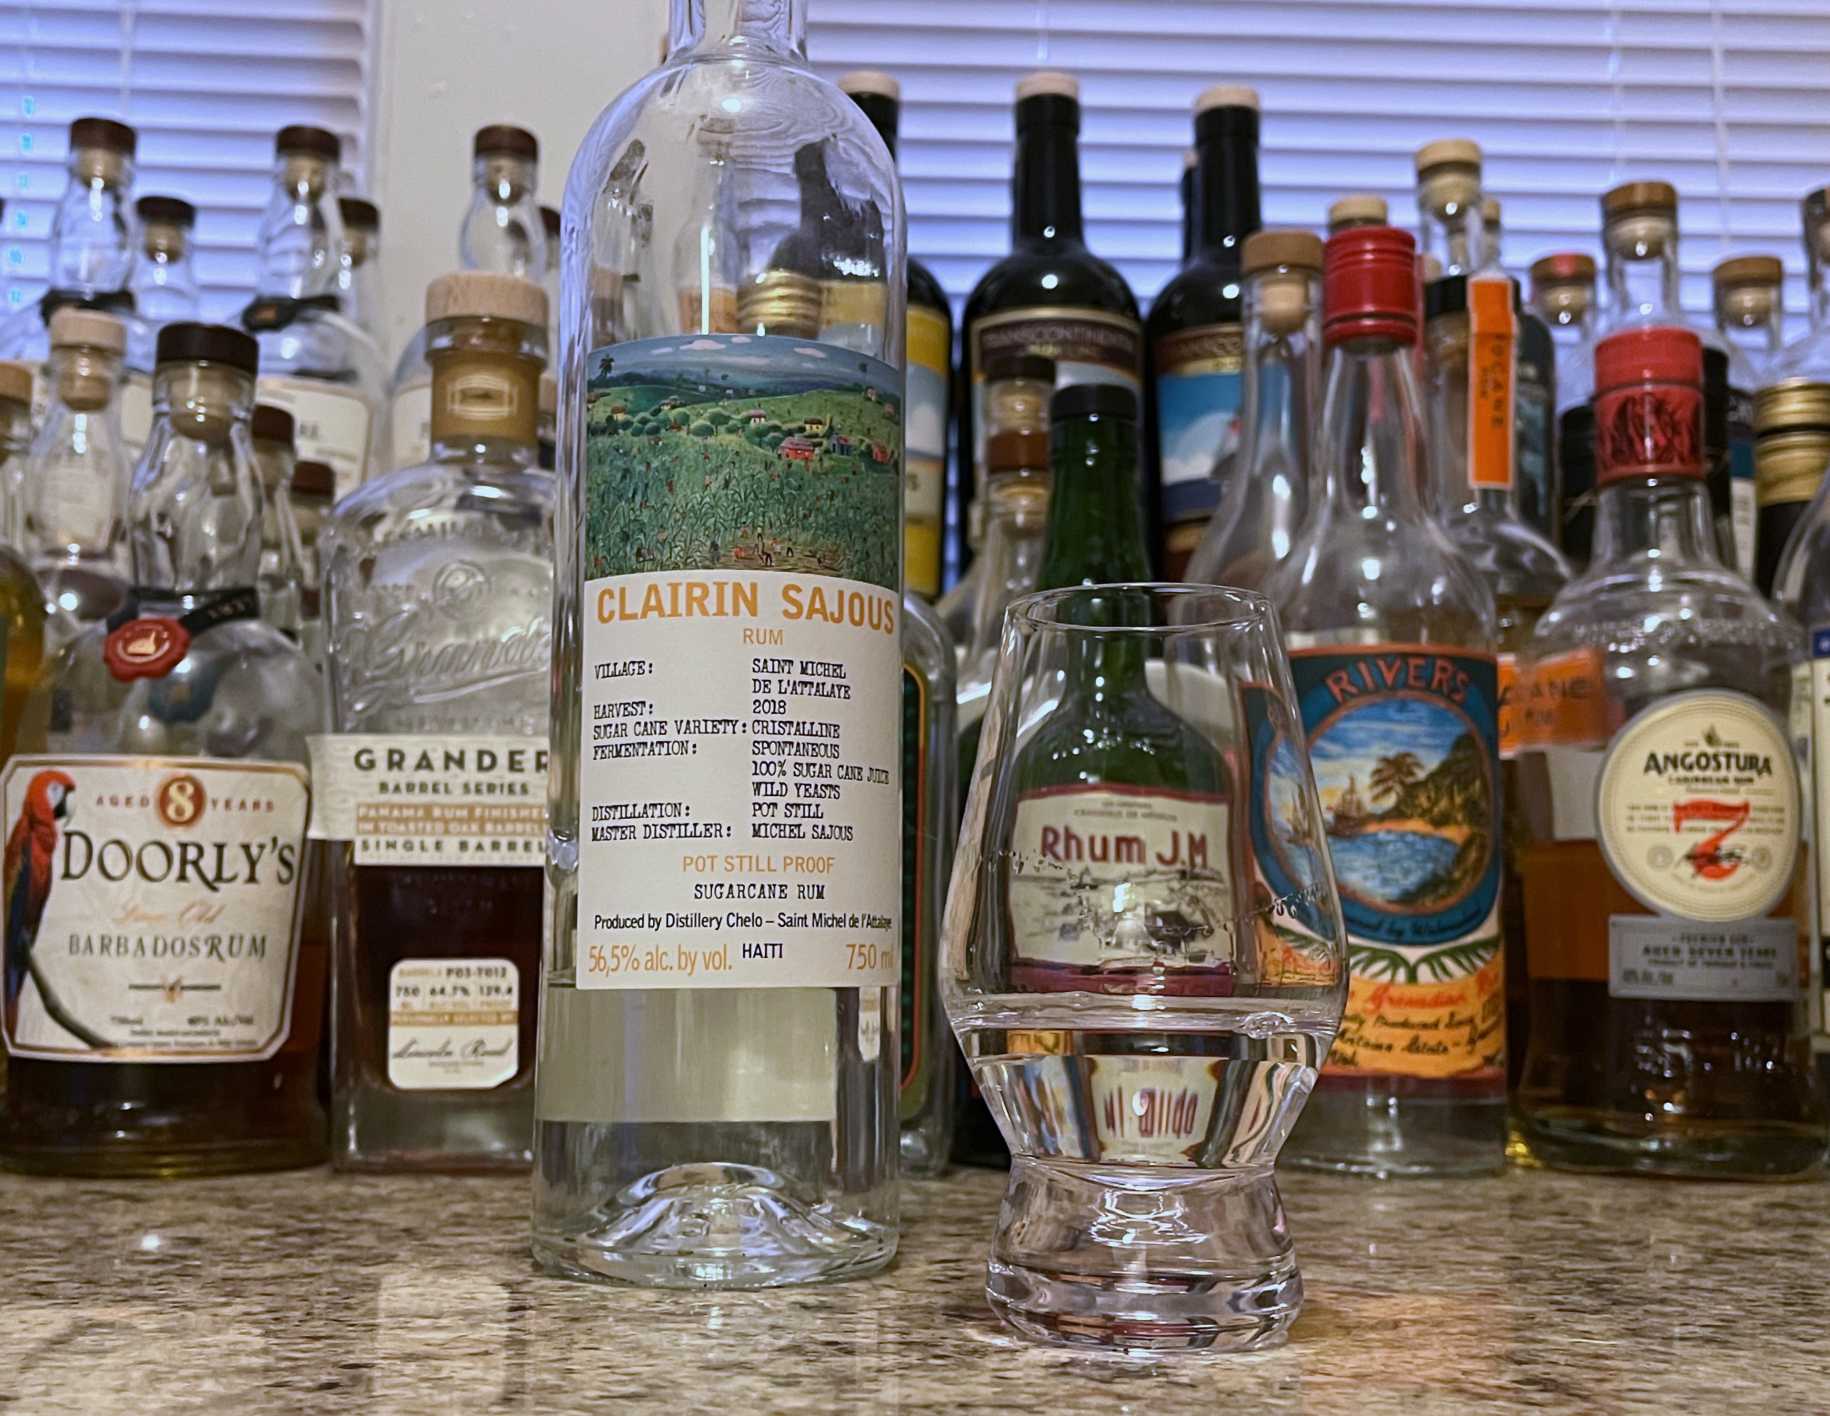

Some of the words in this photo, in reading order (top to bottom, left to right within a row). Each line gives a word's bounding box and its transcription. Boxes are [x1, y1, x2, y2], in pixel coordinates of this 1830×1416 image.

[598, 581, 758, 624] CLAIRIN
[781, 583, 895, 635] SAJOUS
[743, 628, 784, 645] RUM
[594, 661, 653, 679] VILLAGE:
[752, 658, 794, 674] SAINT
[800, 659, 846, 679] MICHEL
[752, 679, 772, 695] DE
[778, 680, 851, 699] L'ATTALAYE
[1325, 656, 1471, 705] RIVERS
[593, 702, 654, 719] HARVEST:
[752, 700, 786, 715] 2018
[593, 723, 627, 740] SUGAR
[633, 721, 667, 736] CANE
[675, 718, 747, 735] VARIETY:
[752, 720, 840, 739] CRISTALLINE
[593, 741, 697, 760] FERMENTATION:
[752, 740, 840, 759] SPONTANEOUS
[354, 749, 549, 774] GRANDER
[752, 760, 786, 776] 100%
[793, 762, 832, 779] SUGAR
[837, 765, 863, 781] CANE
[1643, 750, 1773, 776] ANGOSTURA
[378, 781, 452, 795] BARREL
[462, 781, 529, 796] SERIES
[752, 781, 788, 798] WILD
[795, 782, 841, 799] YEASTS
[96, 794, 150, 808] AGED
[165, 780, 196, 824] 8
[211, 798, 275, 813] YEARS
[432, 806, 469, 818] RUM
[592, 802, 691, 821] DISTILLATION:
[752, 802, 777, 818] POT
[784, 803, 824, 820] STILL
[592, 824, 637, 842] MASTER
[643, 823, 732, 840] DISTILLER:
[752, 823, 805, 839] MICHEL
[812, 824, 854, 842] SAJOUS
[1672, 799, 1750, 880] 7
[361, 840, 443, 852] SINGLE
[1041, 823, 1146, 863] Rhum
[1155, 830, 1208, 868] J.M
[61, 830, 296, 892] DOORLY'S
[683, 856, 717, 873] POT
[724, 856, 776, 873] STILL
[784, 856, 835, 873] PROOF
[694, 884, 788, 900] SUGARCANE
[797, 884, 825, 900] RUM
[594, 913, 645, 930] Produced
[648, 913, 662, 932] by
[666, 912, 722, 931] Distillery
[726, 912, 763, 928] Chelo
[778, 912, 809, 928] Saint
[812, 912, 846, 928] Michel
[849, 912, 860, 929] de
[588, 944, 640, 976] 56,5%
[645, 944, 673, 971] alc.
[678, 944, 698, 976] by
[703, 944, 733, 971] vol.
[741, 943, 784, 959] HAITI
[846, 943, 877, 970] 750
